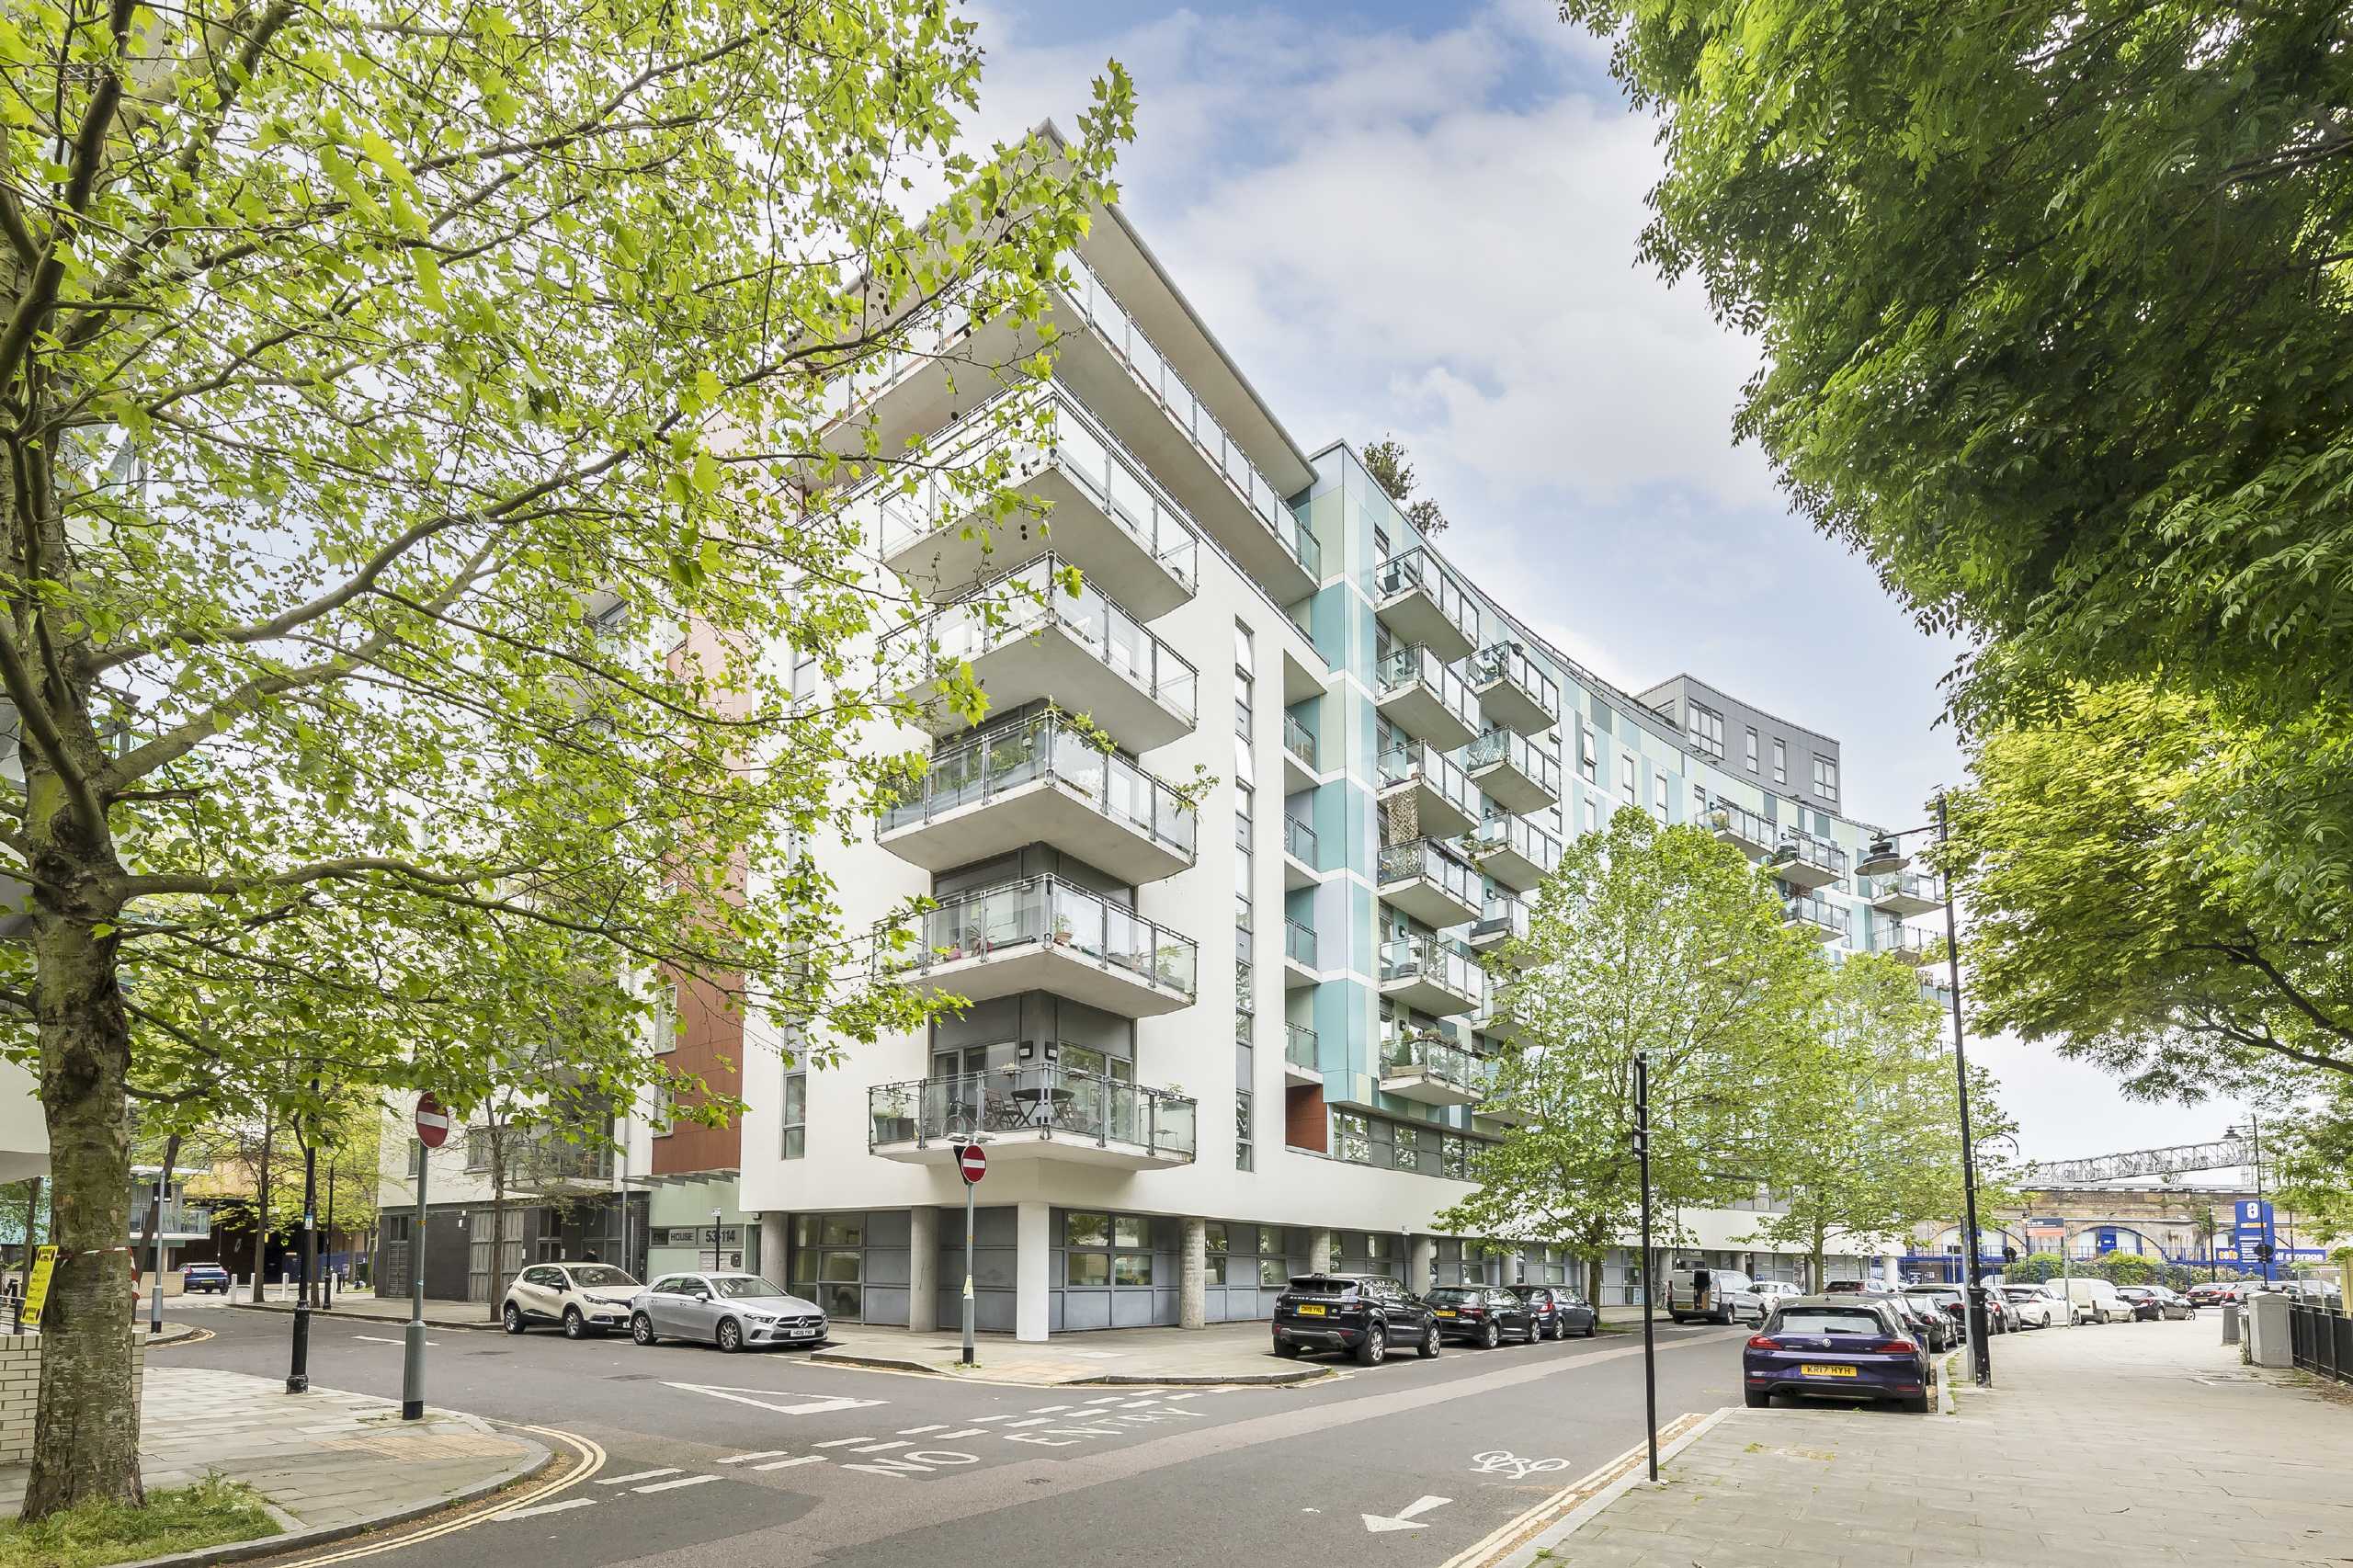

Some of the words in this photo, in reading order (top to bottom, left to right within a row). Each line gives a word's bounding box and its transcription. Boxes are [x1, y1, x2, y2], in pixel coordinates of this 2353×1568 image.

[670, 1233, 694, 1242] HOUSE
[705, 1230, 735, 1243] 53114
[1808, 1366, 1827, 1374] KR17
[1831, 1367, 1851, 1375] HYH
[840, 1450, 981, 1478] NO
[1003, 1407, 1209, 1446] ENTRY
